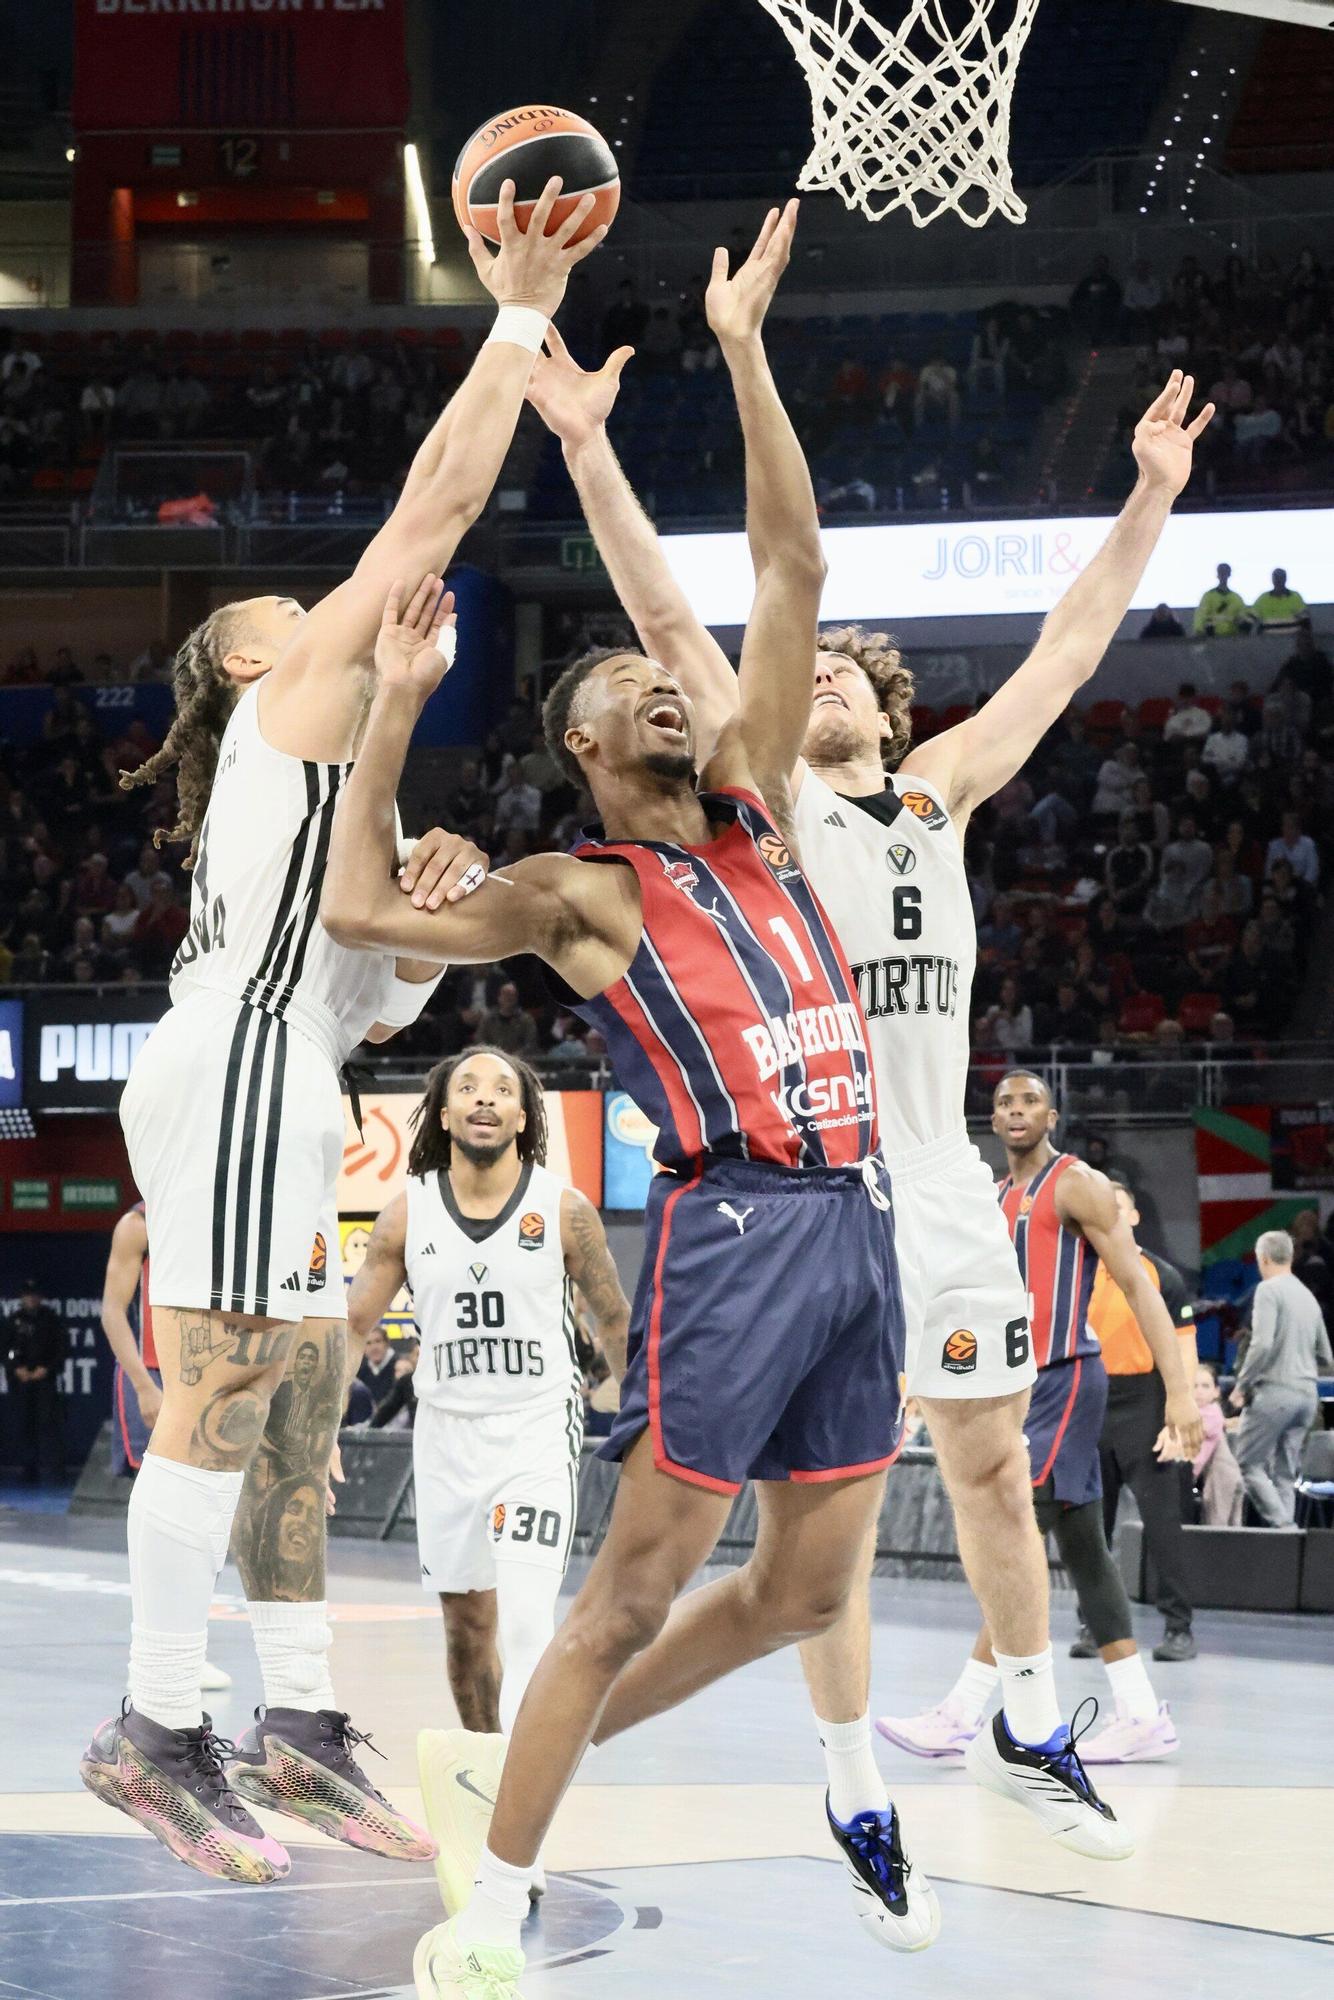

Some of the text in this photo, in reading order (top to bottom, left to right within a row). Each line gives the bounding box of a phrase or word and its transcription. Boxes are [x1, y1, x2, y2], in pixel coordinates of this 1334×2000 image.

[481, 109, 571, 146] ALDING
[222, 139, 257, 175] 12
[892, 886, 922, 940] 6
[768, 916, 813, 983] 1
[454, 1291, 505, 1329] 30
[433, 1337, 545, 1382] VIRTUS
[1005, 1316, 1029, 1369] 6
[512, 1506, 561, 1548] 30
